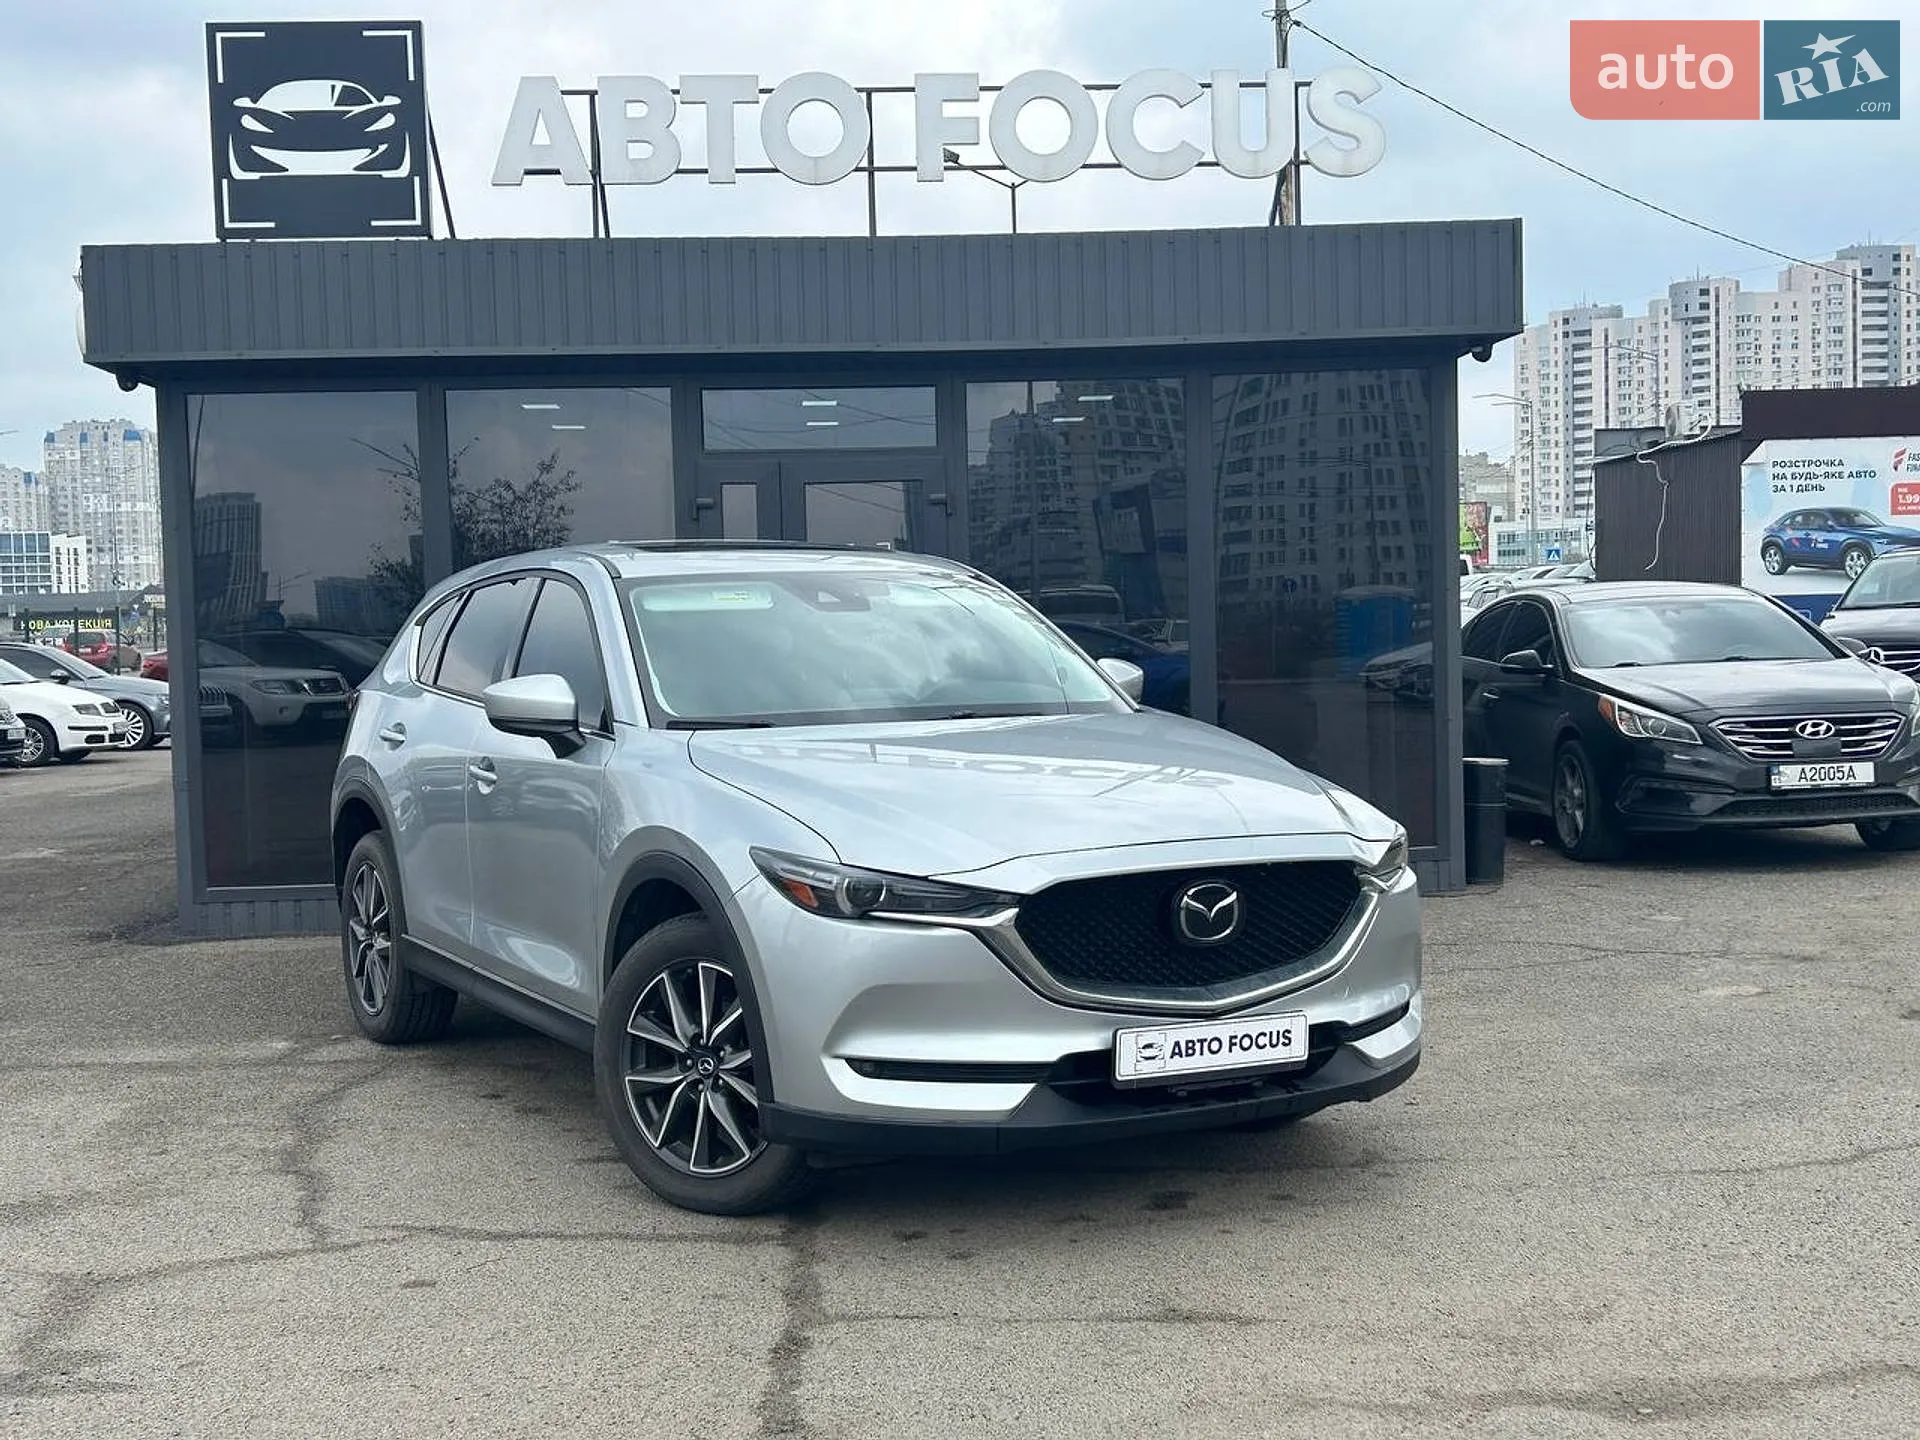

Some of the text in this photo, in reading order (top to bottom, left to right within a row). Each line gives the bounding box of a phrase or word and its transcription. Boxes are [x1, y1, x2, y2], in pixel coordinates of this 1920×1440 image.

[491, 67, 1387, 185] АВТО FOCUS
[1771, 458, 1845, 469] РОЗСТРОЧКА
[1771, 469, 1877, 481] НА БУДЬ-ЯКЕ АВТО
[1772, 483, 1826, 493] ЗА 1 ДЕНЬ
[1798, 765, 1857, 783] A2005A
[1169, 1028, 1293, 1060] АВТО FOCUS
